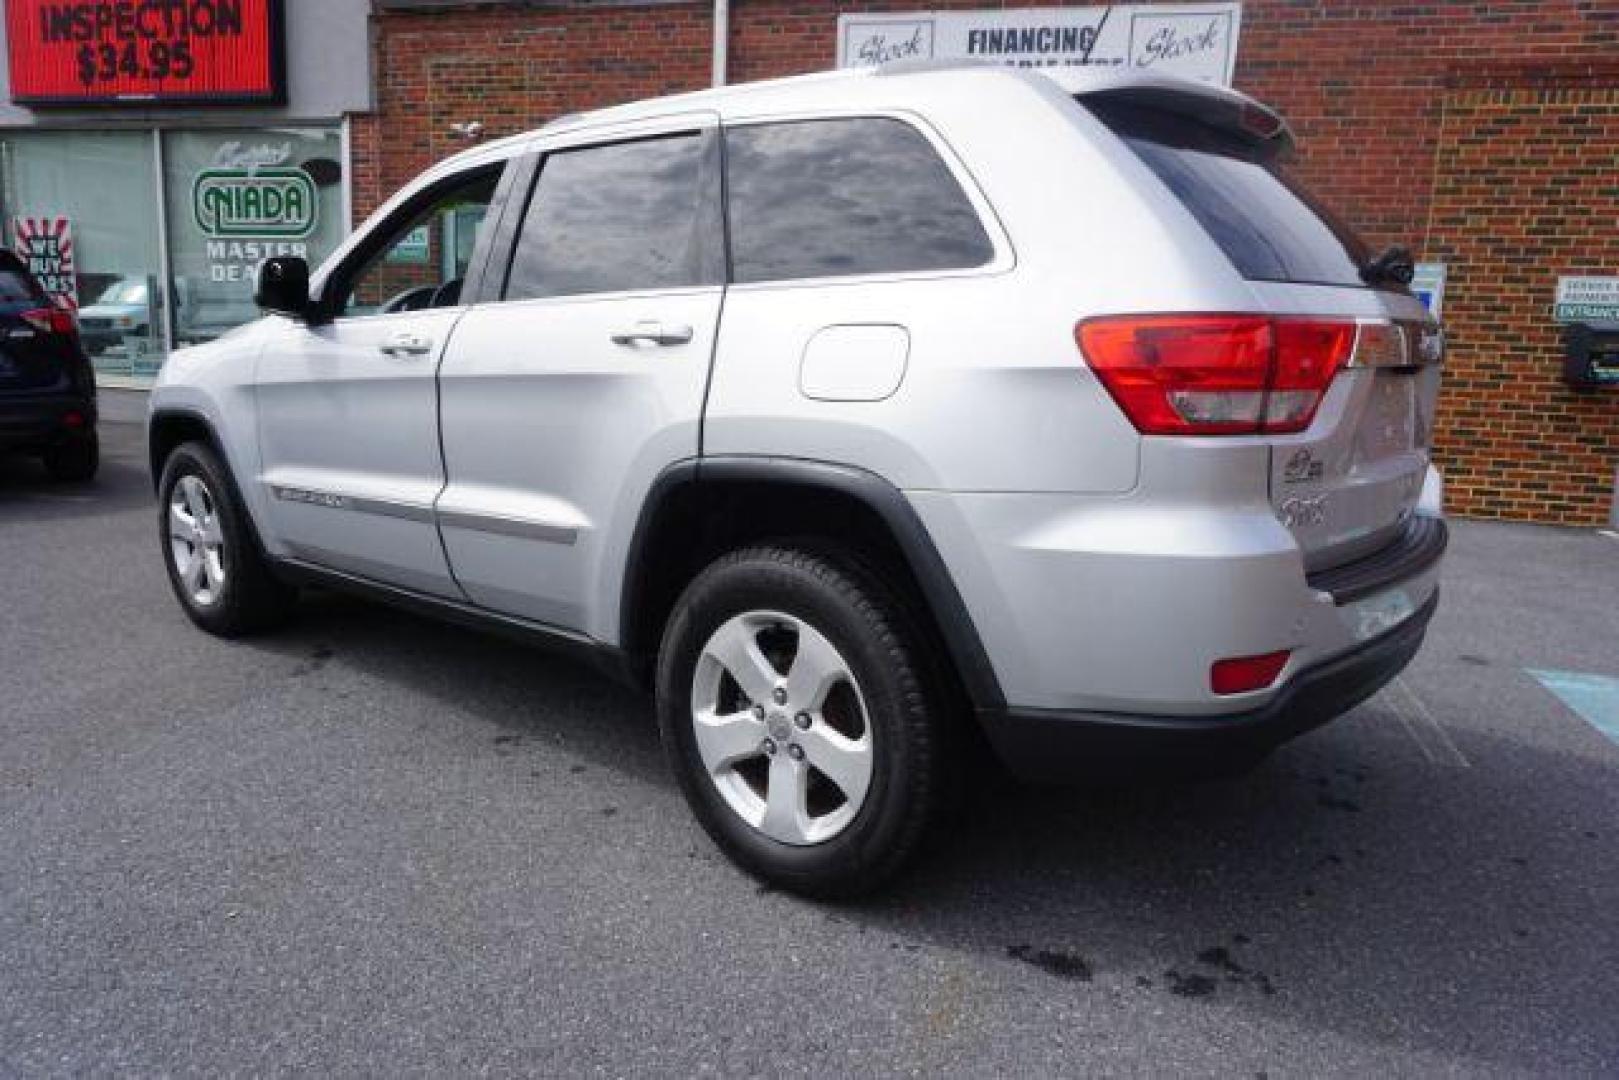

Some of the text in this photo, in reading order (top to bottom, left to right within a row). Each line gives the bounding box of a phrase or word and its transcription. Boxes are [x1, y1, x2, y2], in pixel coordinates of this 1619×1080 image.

[39, 0, 242, 40] INSPECTION
[968, 27, 1095, 54] FINANCING
[76, 40, 194, 85] $34.95
[203, 185, 302, 222] NIADA
[206, 242, 306, 259] MASTER
